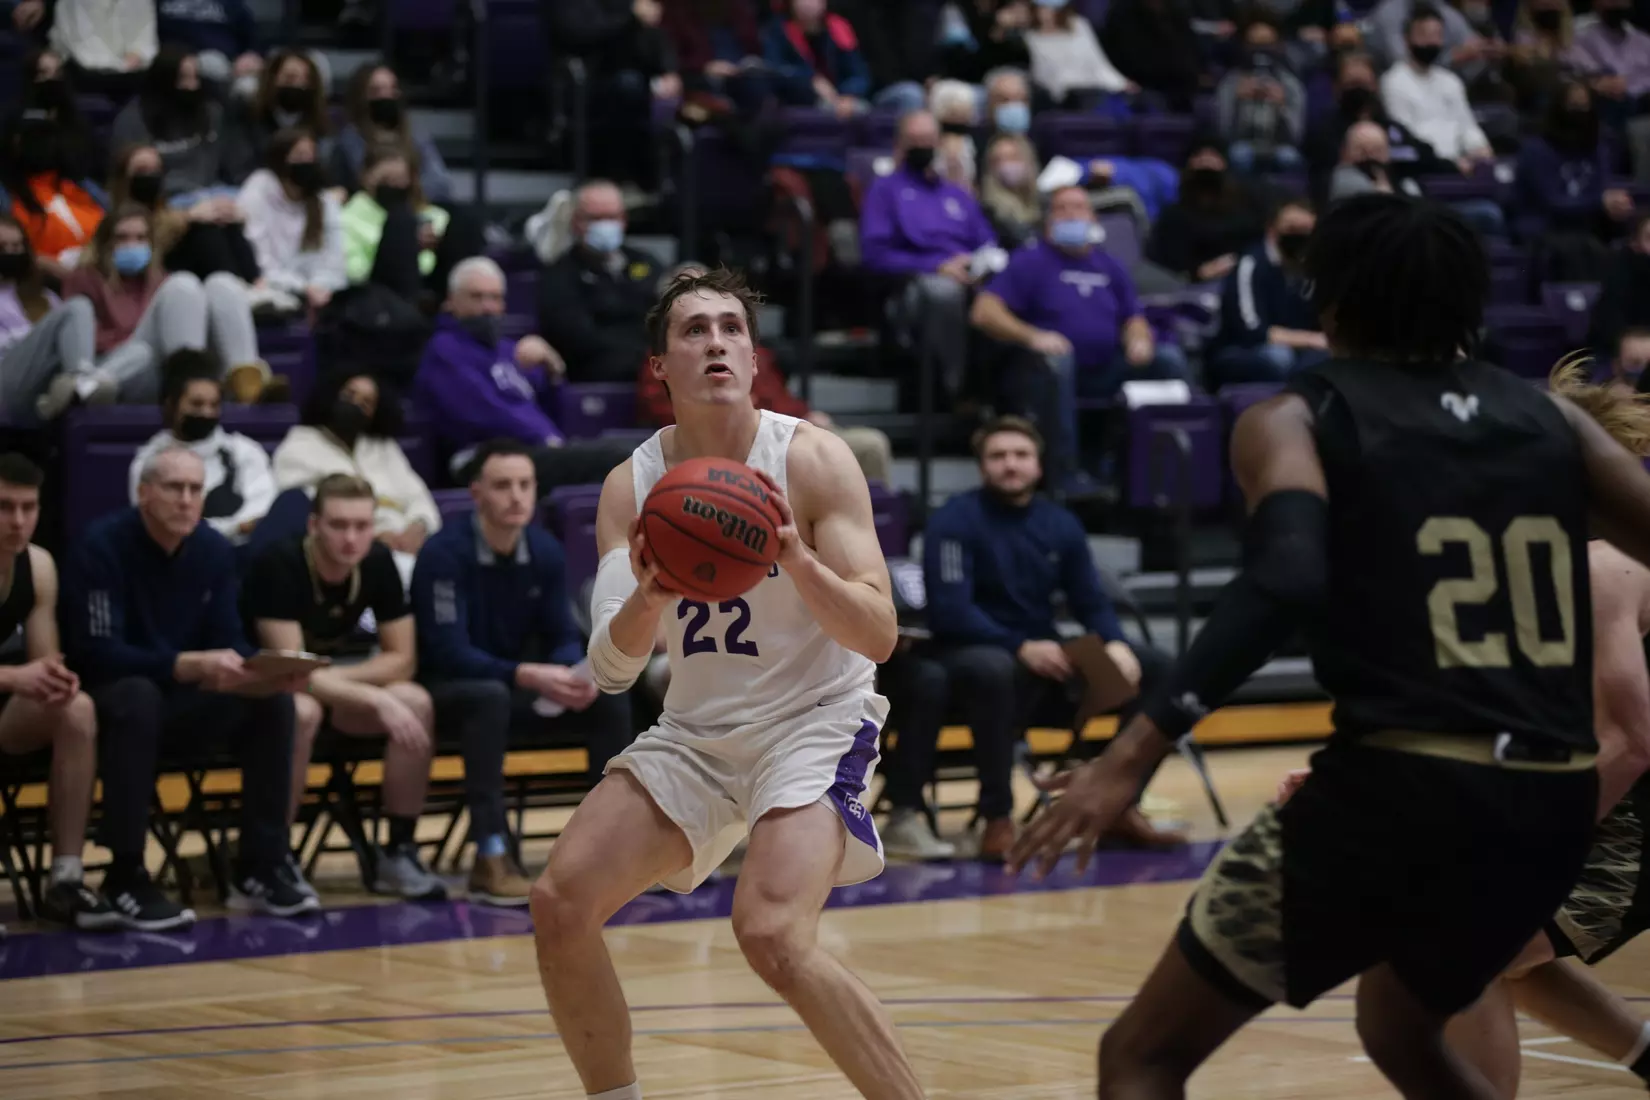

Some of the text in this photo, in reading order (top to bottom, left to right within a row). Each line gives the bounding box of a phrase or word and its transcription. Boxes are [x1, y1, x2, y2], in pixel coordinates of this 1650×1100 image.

[708, 467, 768, 505] NCAA
[682, 496, 768, 555] Wilson
[1416, 515, 1576, 669] 20
[677, 597, 759, 658] 22
